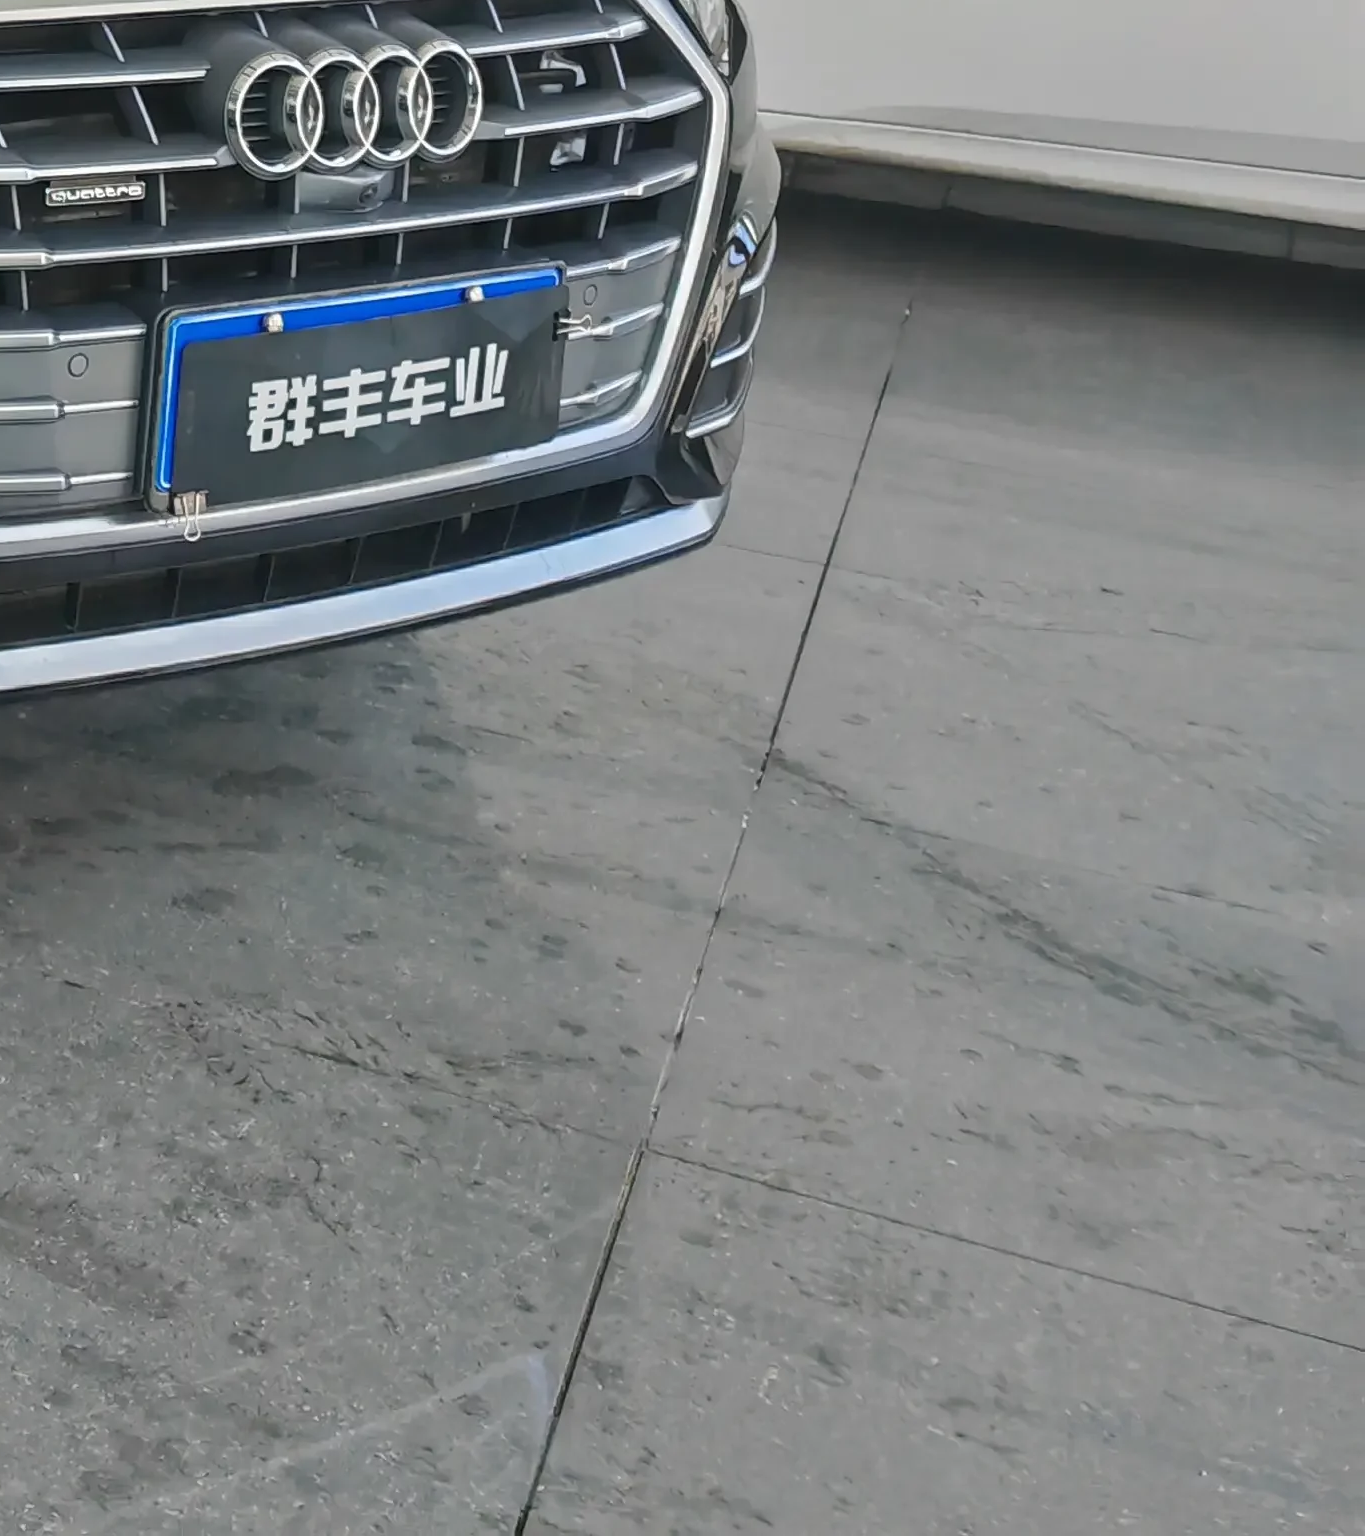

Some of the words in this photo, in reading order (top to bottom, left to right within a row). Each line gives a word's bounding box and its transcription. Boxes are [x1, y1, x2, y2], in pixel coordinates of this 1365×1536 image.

[51, 185, 142, 203] quattro
[247, 343, 509, 452] 群丰车业
